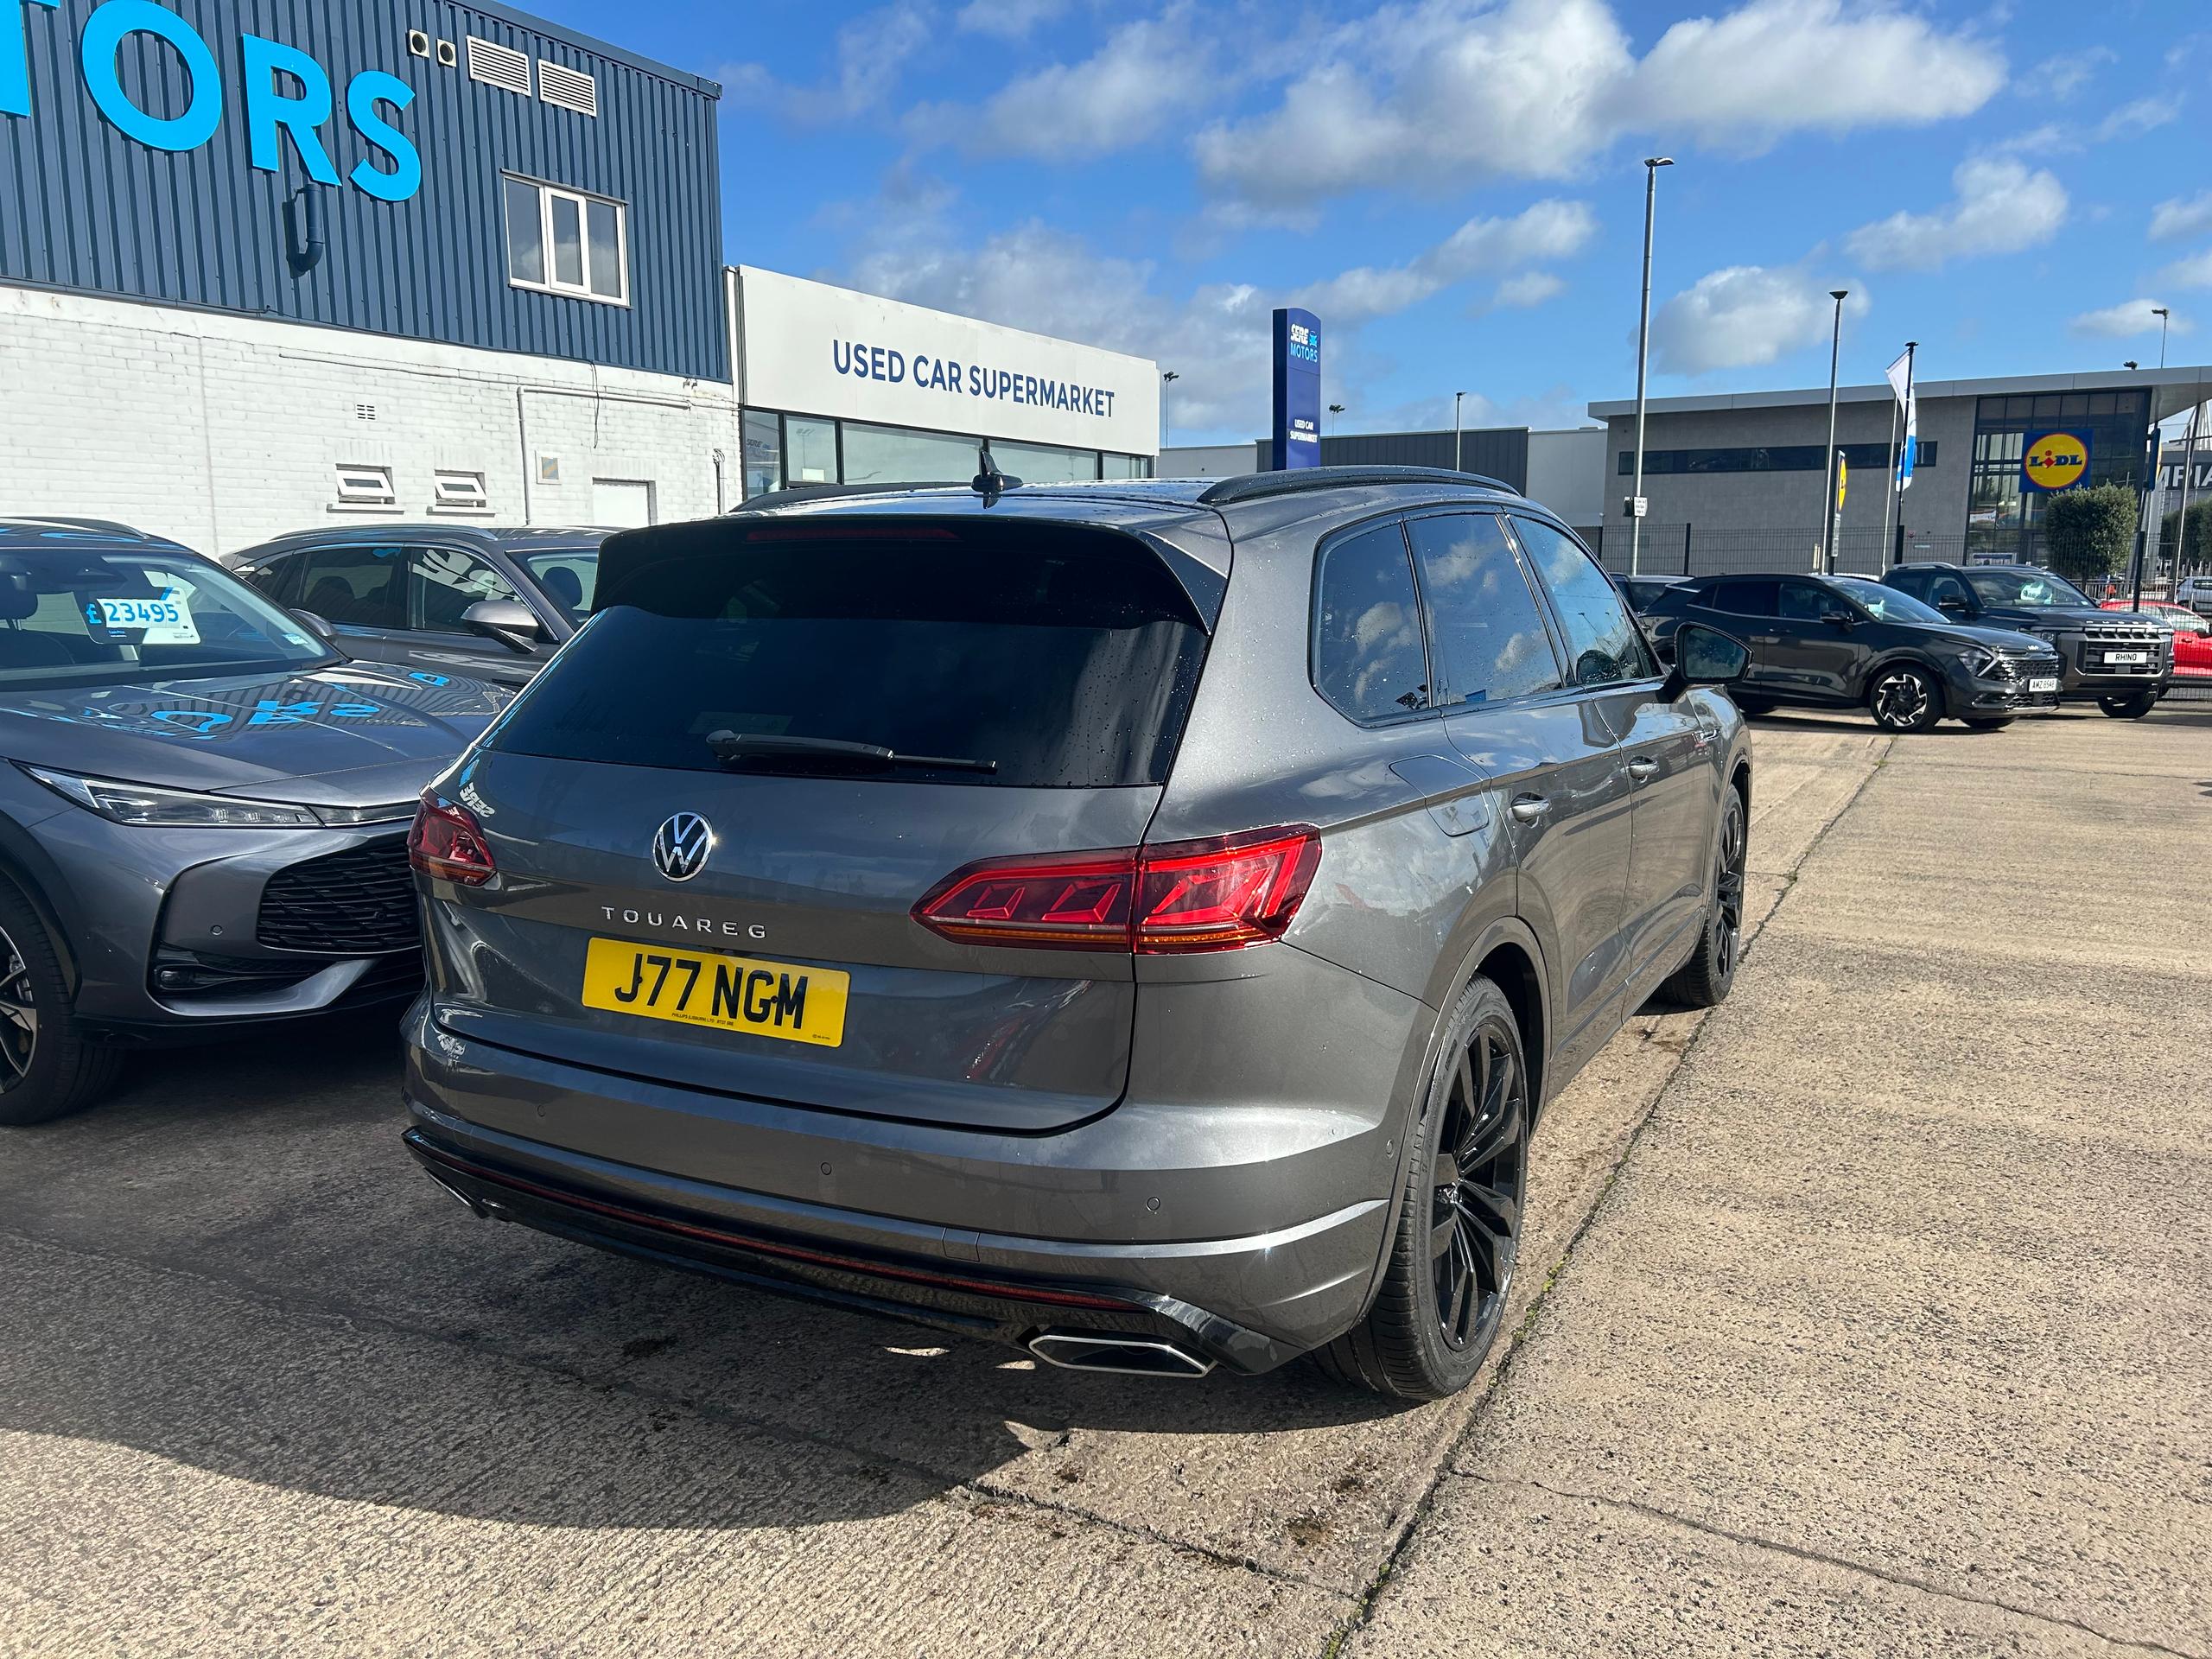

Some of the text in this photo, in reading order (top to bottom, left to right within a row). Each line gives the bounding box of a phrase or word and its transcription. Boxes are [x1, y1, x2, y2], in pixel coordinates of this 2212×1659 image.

[1290, 324, 1309, 345] SERE
[1290, 342, 1318, 362] MOTORS
[833, 340, 1115, 417] USED CAR SUPERMARKET
[601, 906, 766, 938] TOUAREG
[614, 953, 809, 1029] J77 NGM
